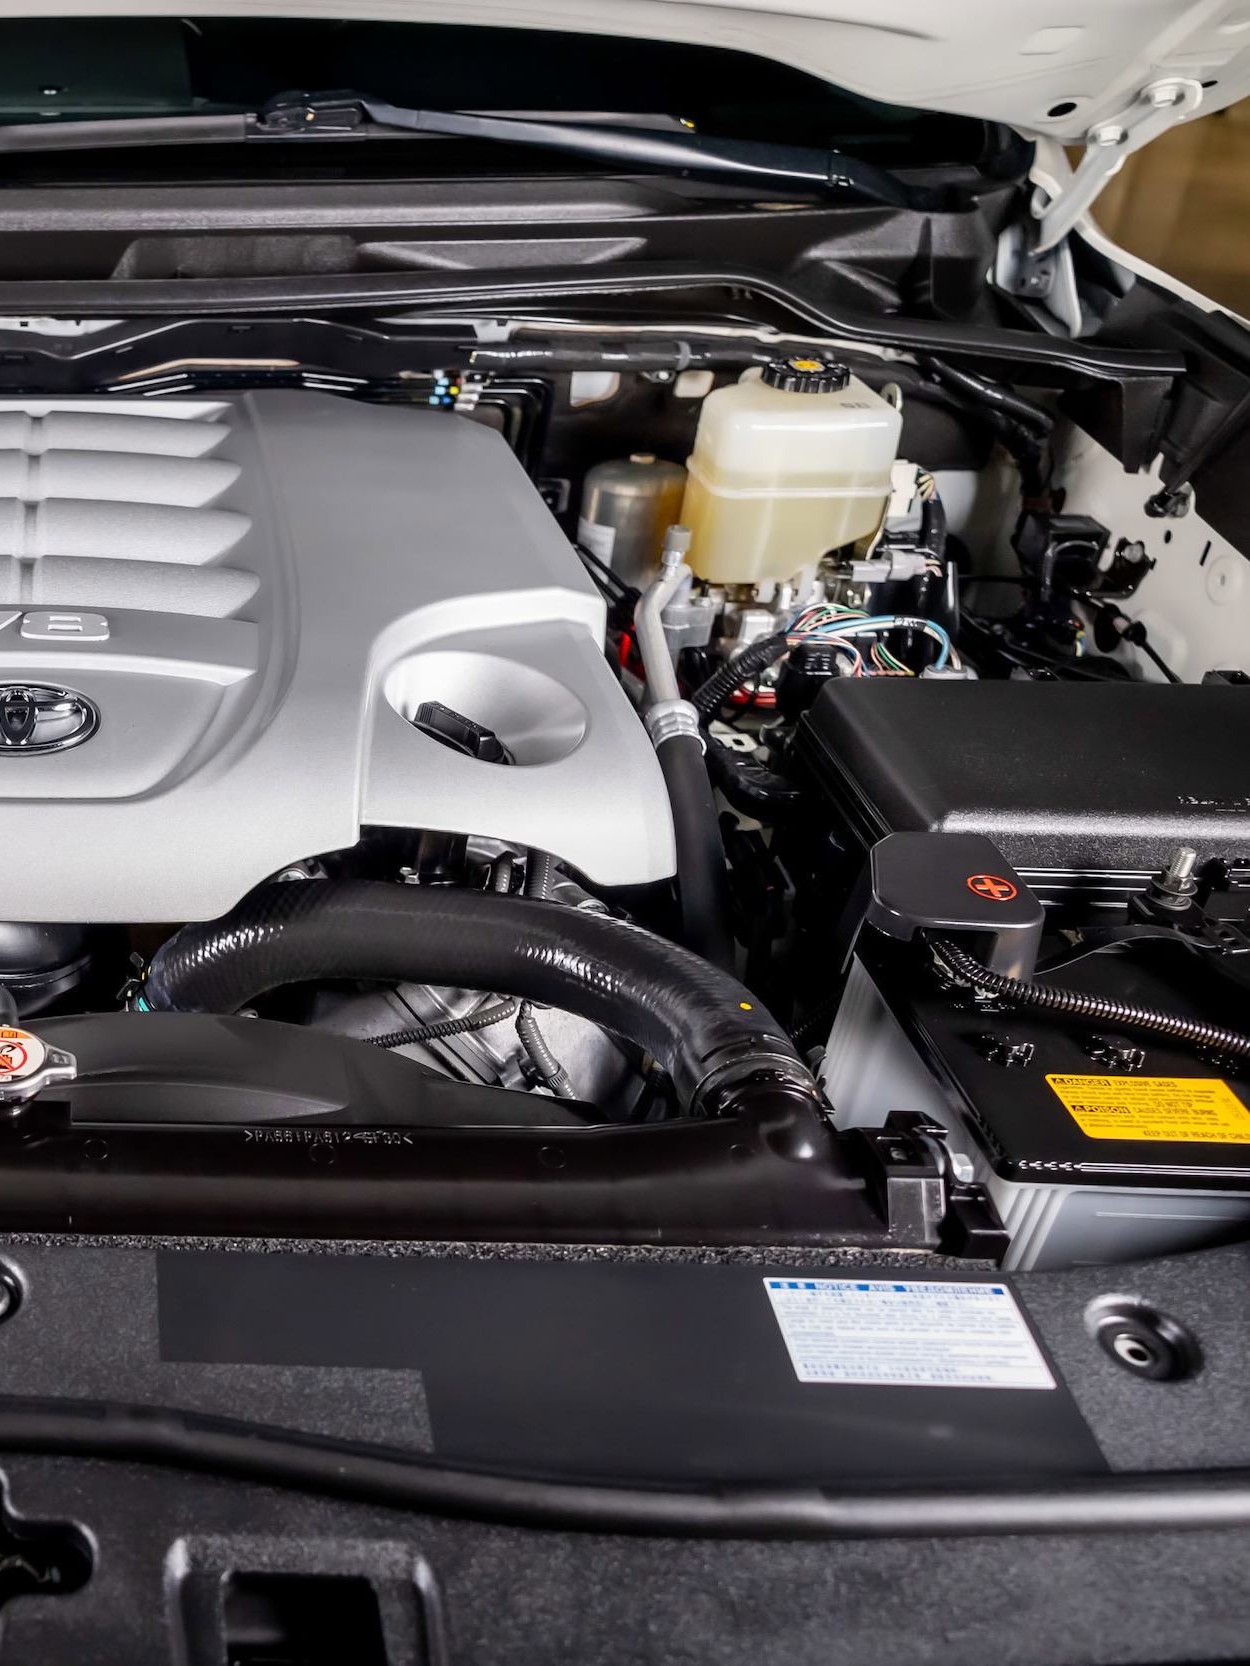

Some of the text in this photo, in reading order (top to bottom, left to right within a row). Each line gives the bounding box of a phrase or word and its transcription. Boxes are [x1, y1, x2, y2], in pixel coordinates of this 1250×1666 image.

[1064, 1078, 1110, 1086] DANGER
[1191, 1131, 1216, 1139] REACH
[815, 1282, 858, 1291] NOTICE
[869, 1284, 895, 1292] AVIS
